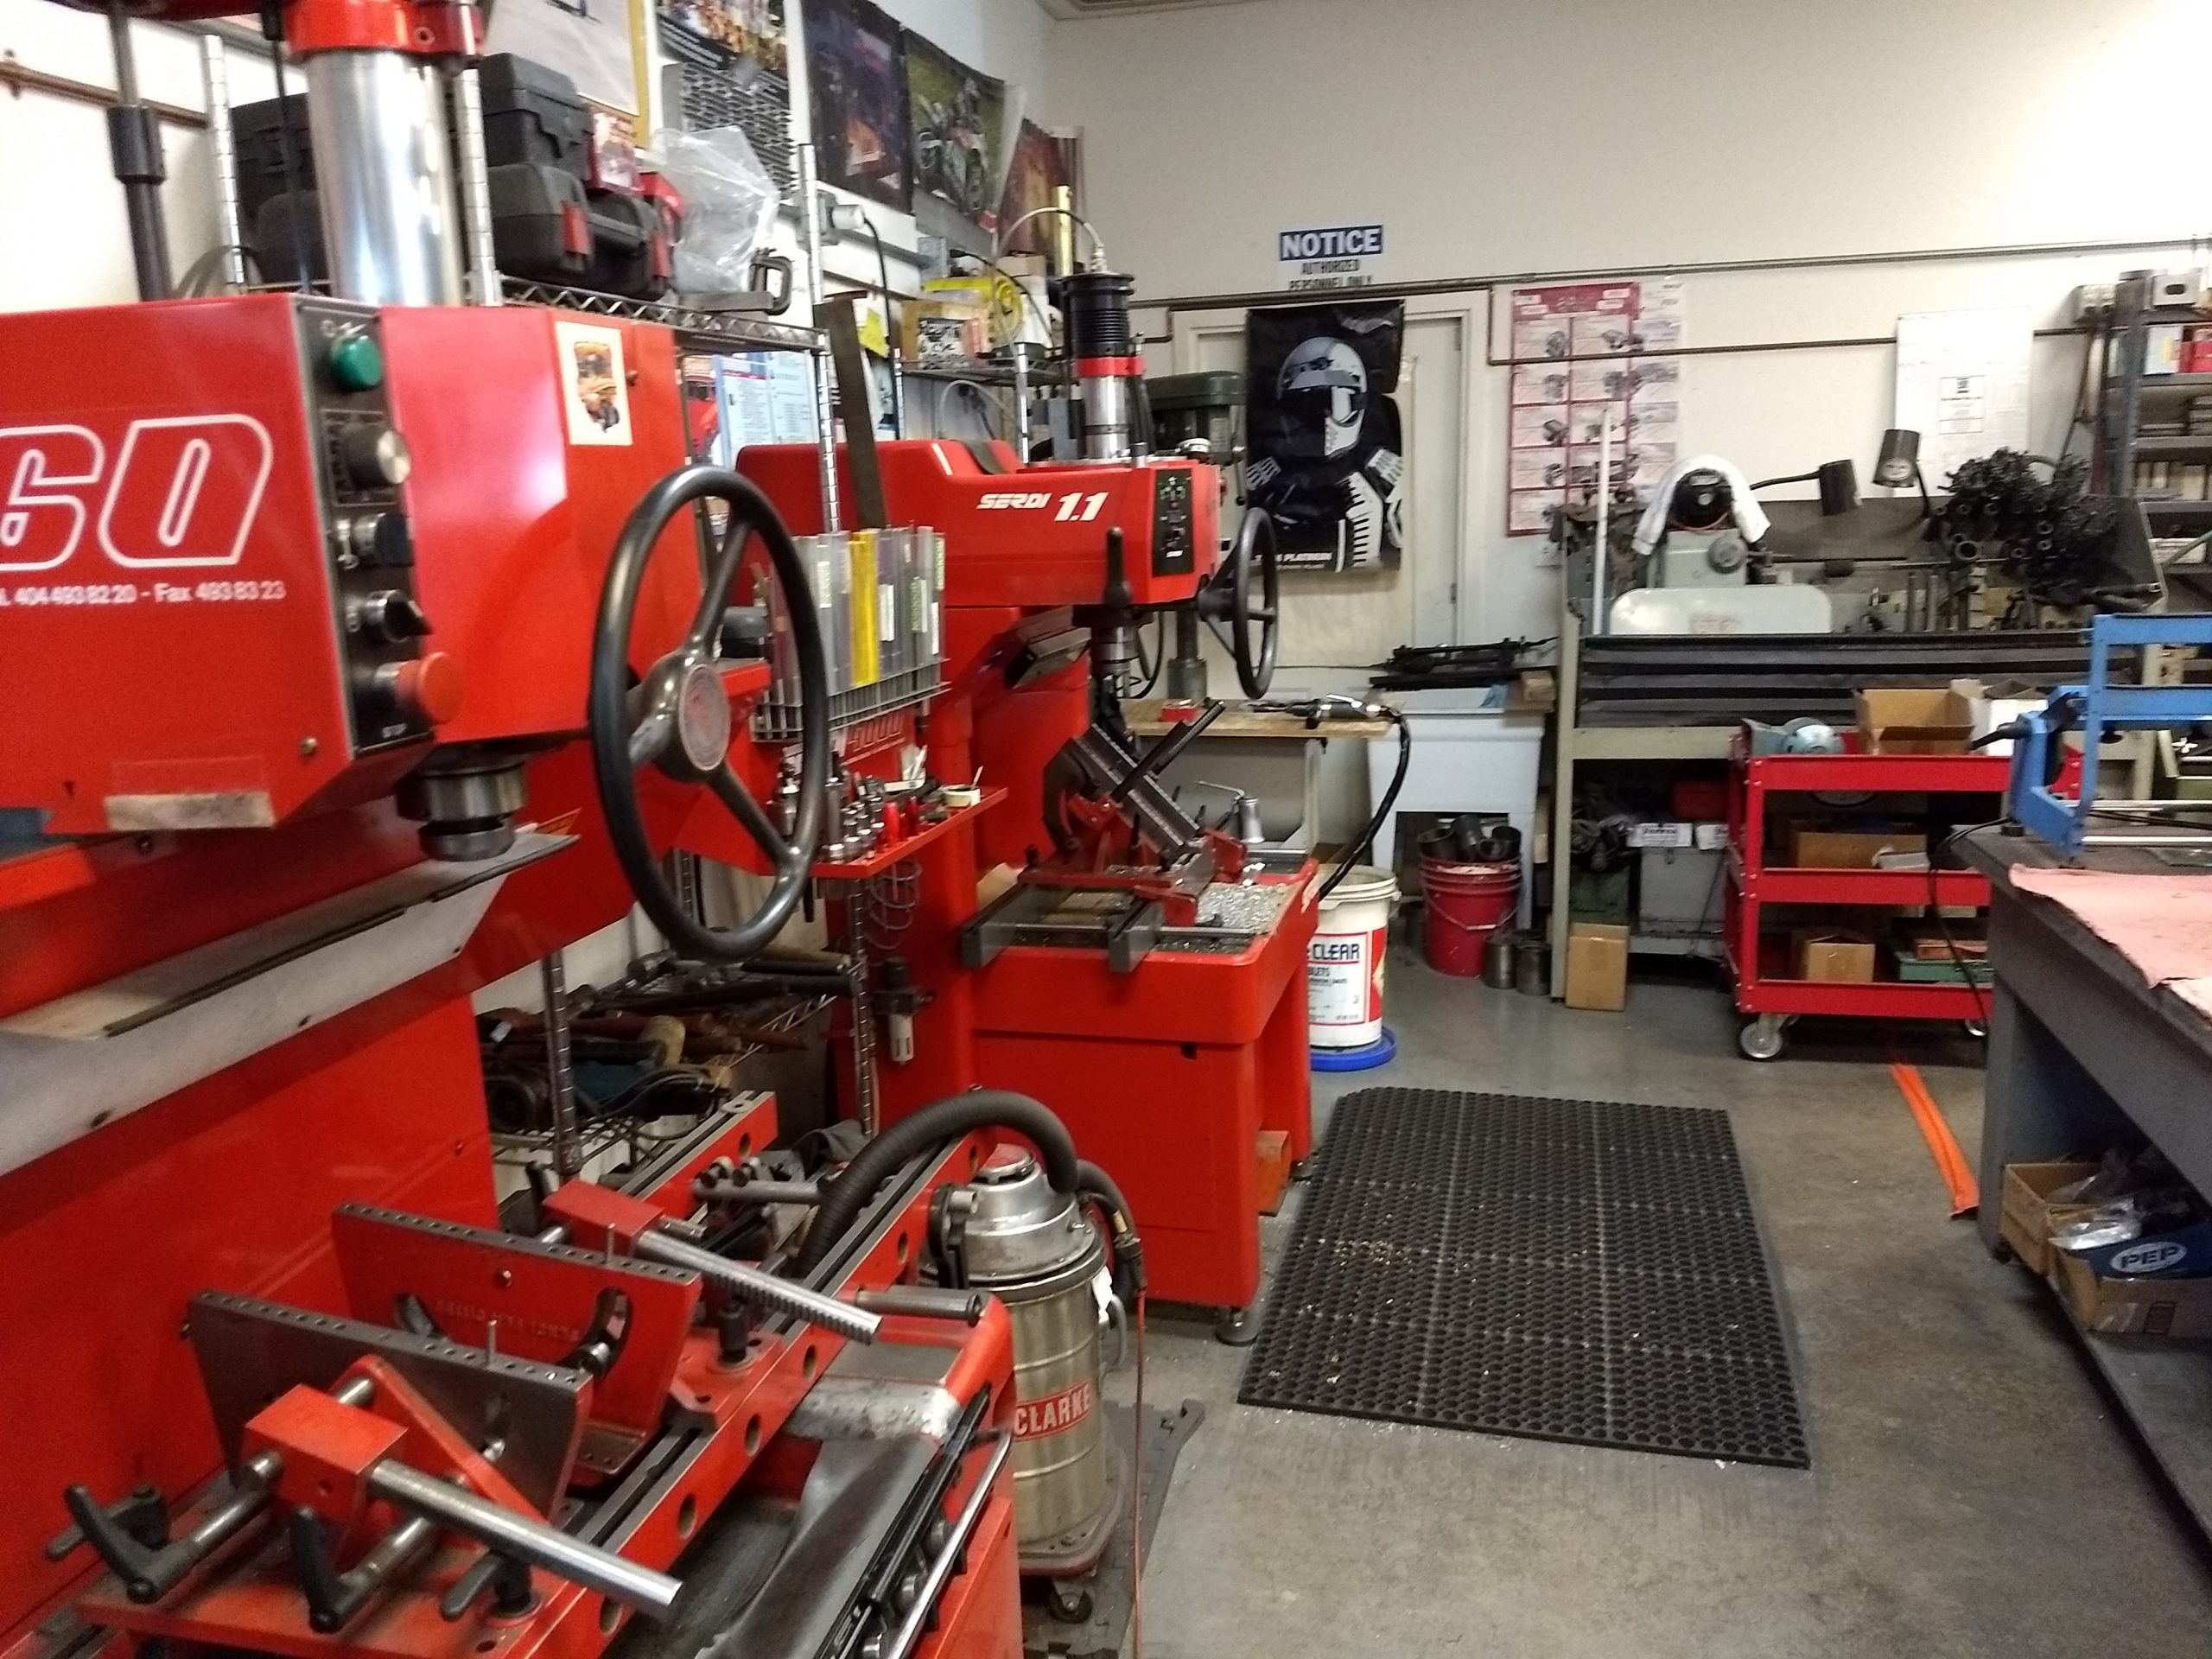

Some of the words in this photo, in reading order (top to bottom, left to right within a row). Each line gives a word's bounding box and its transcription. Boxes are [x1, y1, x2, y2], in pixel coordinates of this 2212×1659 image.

[1282, 228, 1381, 258] NOTICE
[1301, 259, 1360, 275] AUTHORIZED
[1288, 276, 1344, 291] PERSONNEL
[976, 492, 1052, 509] SERDI
[1054, 491, 1109, 522] 1.1
[154, 582, 194, 602] Fax
[1313, 943, 1360, 960] CLEAR
[2120, 1246, 2178, 1269] PEP
[1014, 1382, 1090, 1435] CLARKE
